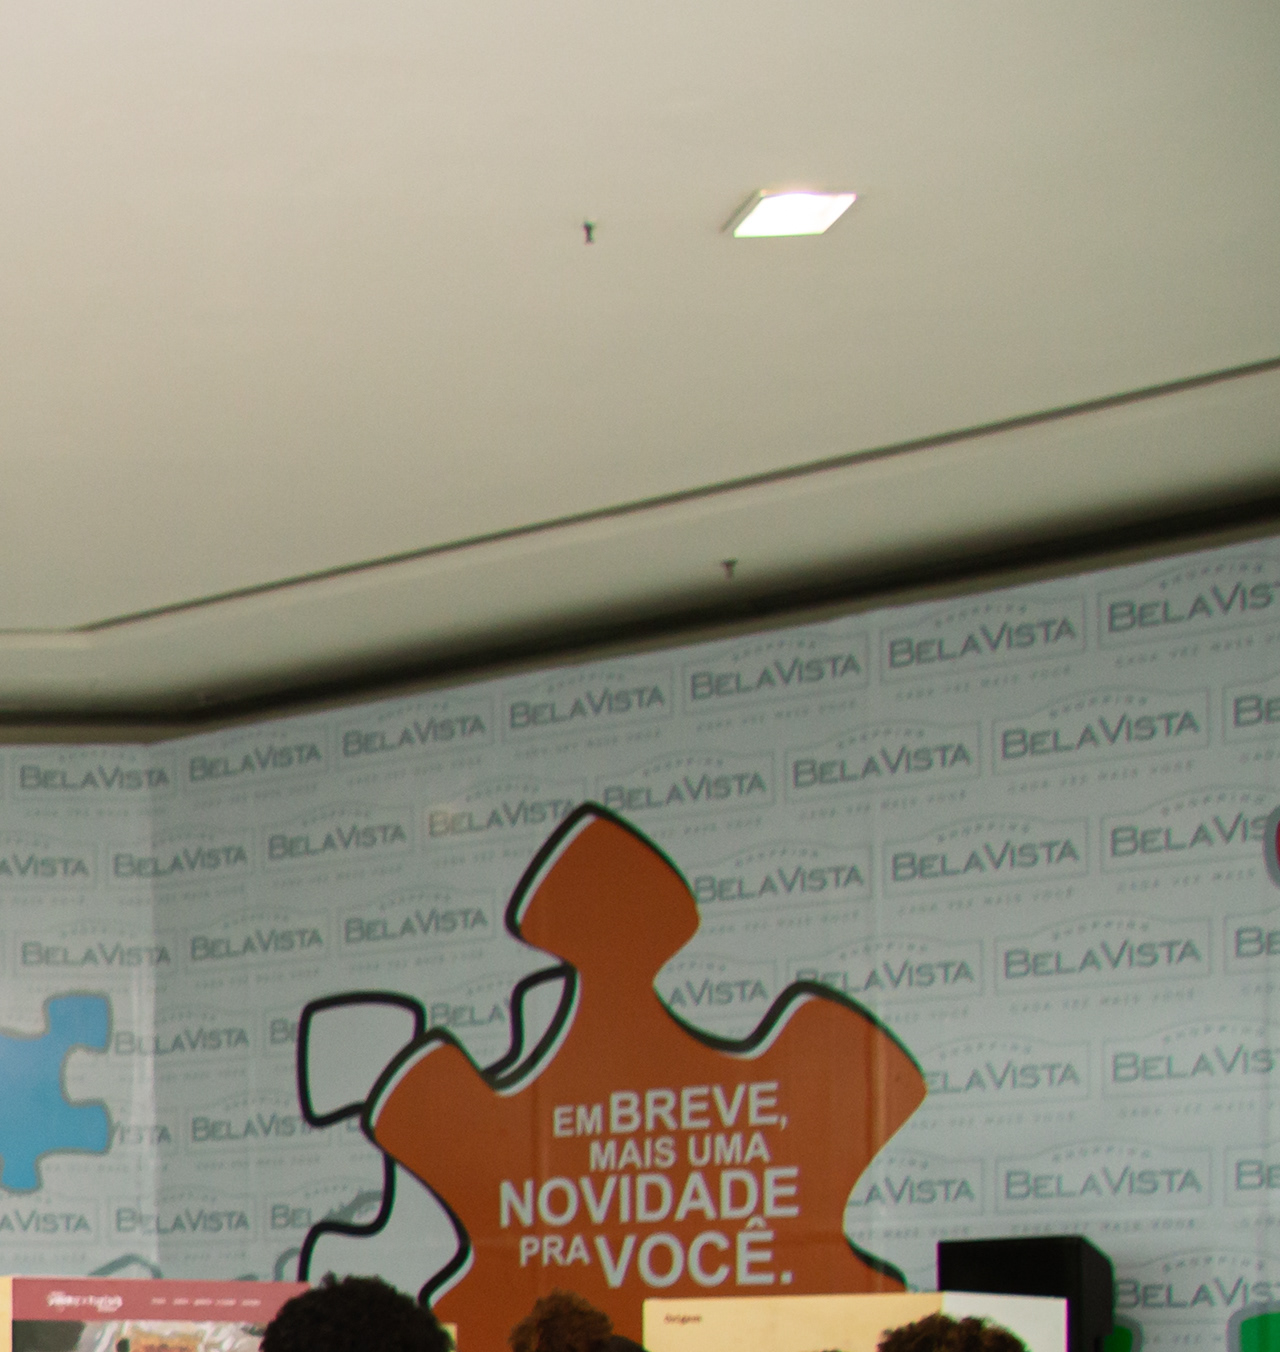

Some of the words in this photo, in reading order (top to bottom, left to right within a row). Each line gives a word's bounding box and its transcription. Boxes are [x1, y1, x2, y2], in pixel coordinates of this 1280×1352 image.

[1108, 580, 1280, 634] BELAVIS
[888, 616, 1078, 671] BELAVISTA
[690, 652, 863, 701] BELAVISTA
[509, 684, 666, 731] BELAVISTA
[342, 713, 487, 758] BELAVISTA
[1001, 709, 1200, 761] BELAVISTA
[21, 764, 170, 791] BELAVISTA
[188, 741, 323, 784] BELAVISTA
[792, 742, 972, 789] BELAVISTA
[268, 823, 408, 861] BELAVISTA
[1110, 811, 1266, 859] BELAVIS
[113, 844, 248, 879] BELAVISTA
[892, 838, 1080, 883] BELAVISTA
[694, 864, 865, 904] BELAVISTA
[189, 926, 324, 962] BELAVISTA
[344, 907, 488, 944] BELAVISTA
[20, 940, 171, 967] BELAVISTA
[1004, 939, 1202, 980] BELAVISTA
[669, 977, 769, 1008] AVISTA
[927, 1060, 1081, 1096] ELAVISTA
[1112, 1043, 1280, 1085] BELAVIS
[553, 1104, 603, 1138] EM
[608, 1081, 789, 1135] BREVE,
[588, 1134, 677, 1172] MAIS
[687, 1131, 771, 1167] UMA
[498, 1166, 800, 1229] NOVIDADE
[852, 1174, 976, 1205] AVISTA
[1004, 1164, 1203, 1200] BELAVISTA
[519, 1236, 590, 1268] PRA
[593, 1217, 794, 1289] VOCÊ.
[1115, 1275, 1280, 1310] BELAVIS
